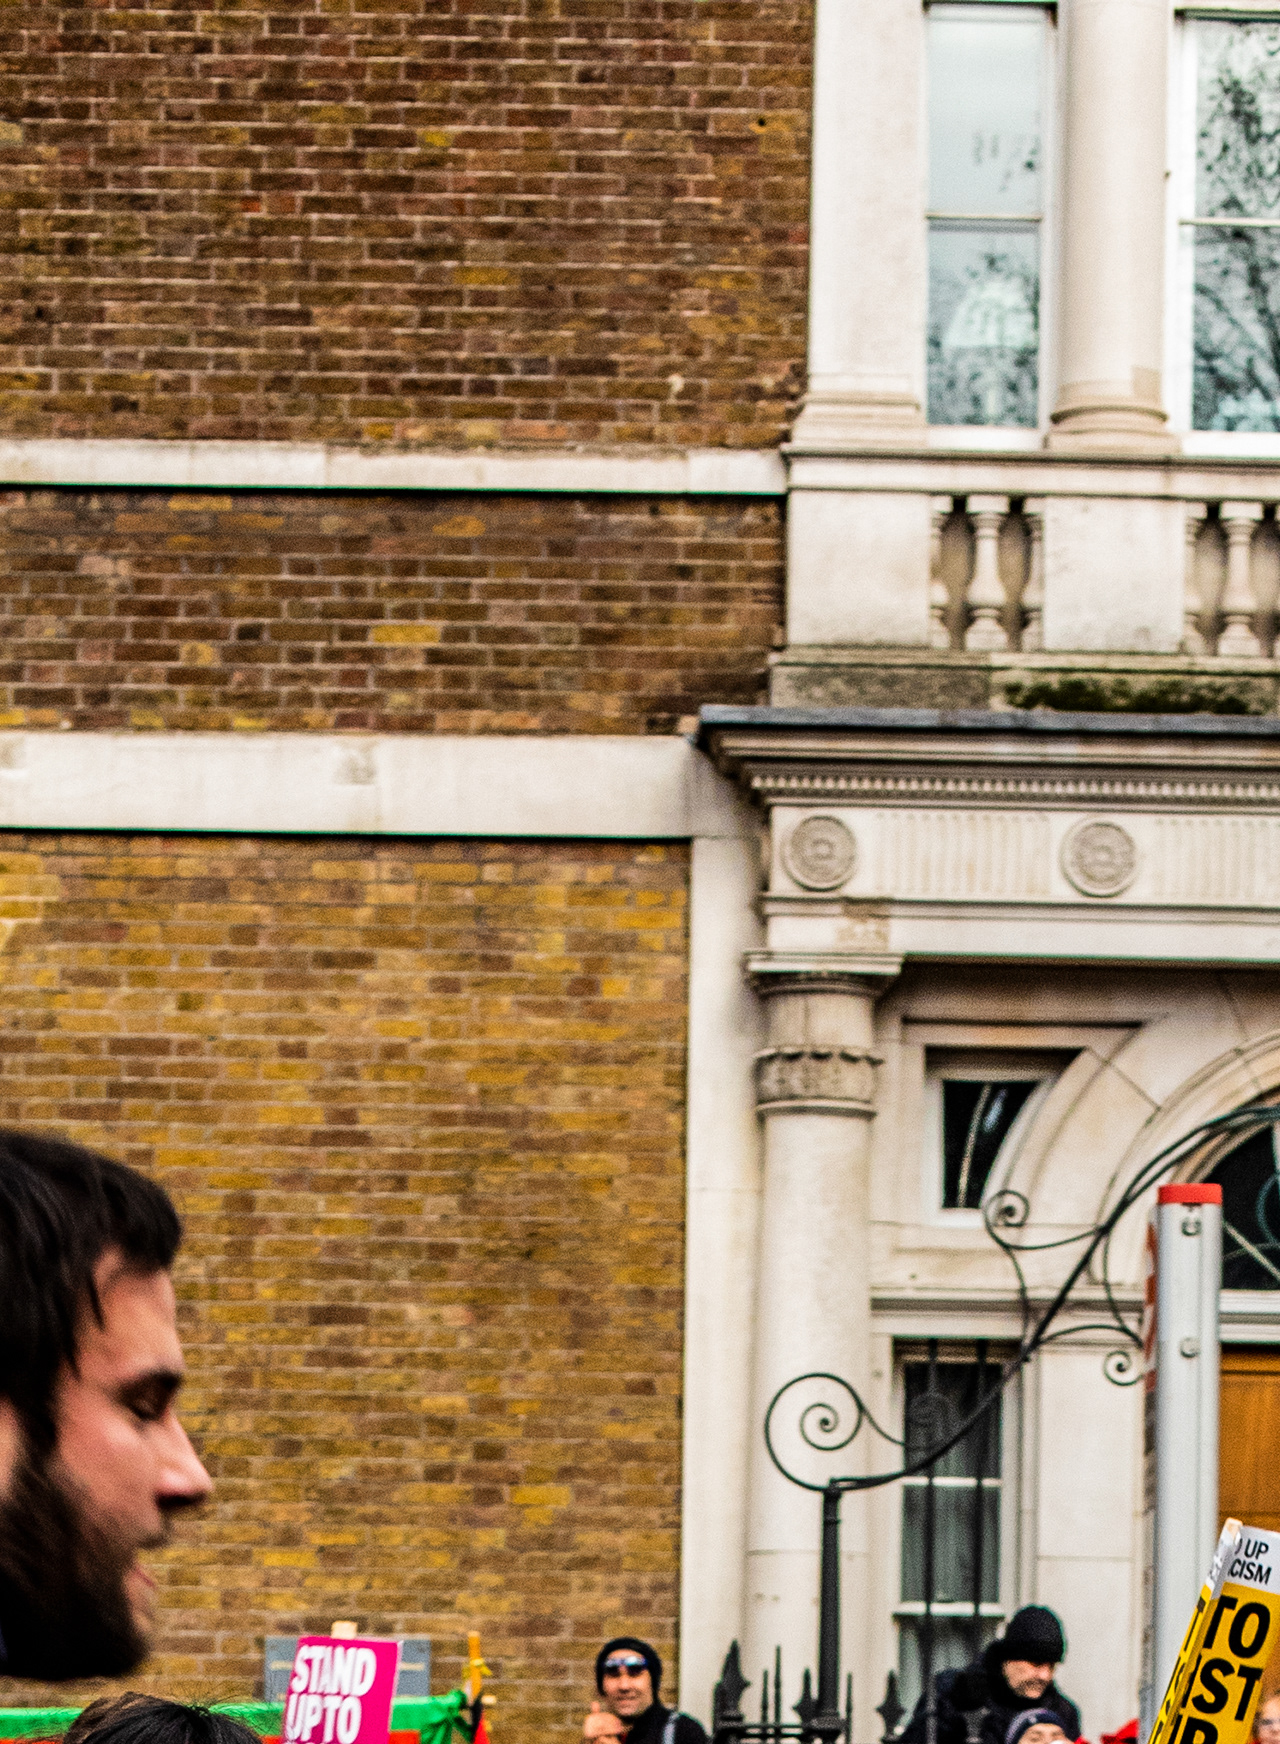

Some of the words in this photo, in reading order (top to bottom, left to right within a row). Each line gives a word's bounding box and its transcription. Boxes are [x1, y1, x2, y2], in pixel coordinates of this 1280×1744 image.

[1244, 1537, 1270, 1562] UP
[1227, 1558, 1273, 1586] CISM
[1203, 1595, 1271, 1660] TO
[291, 1645, 377, 1697] STAND
